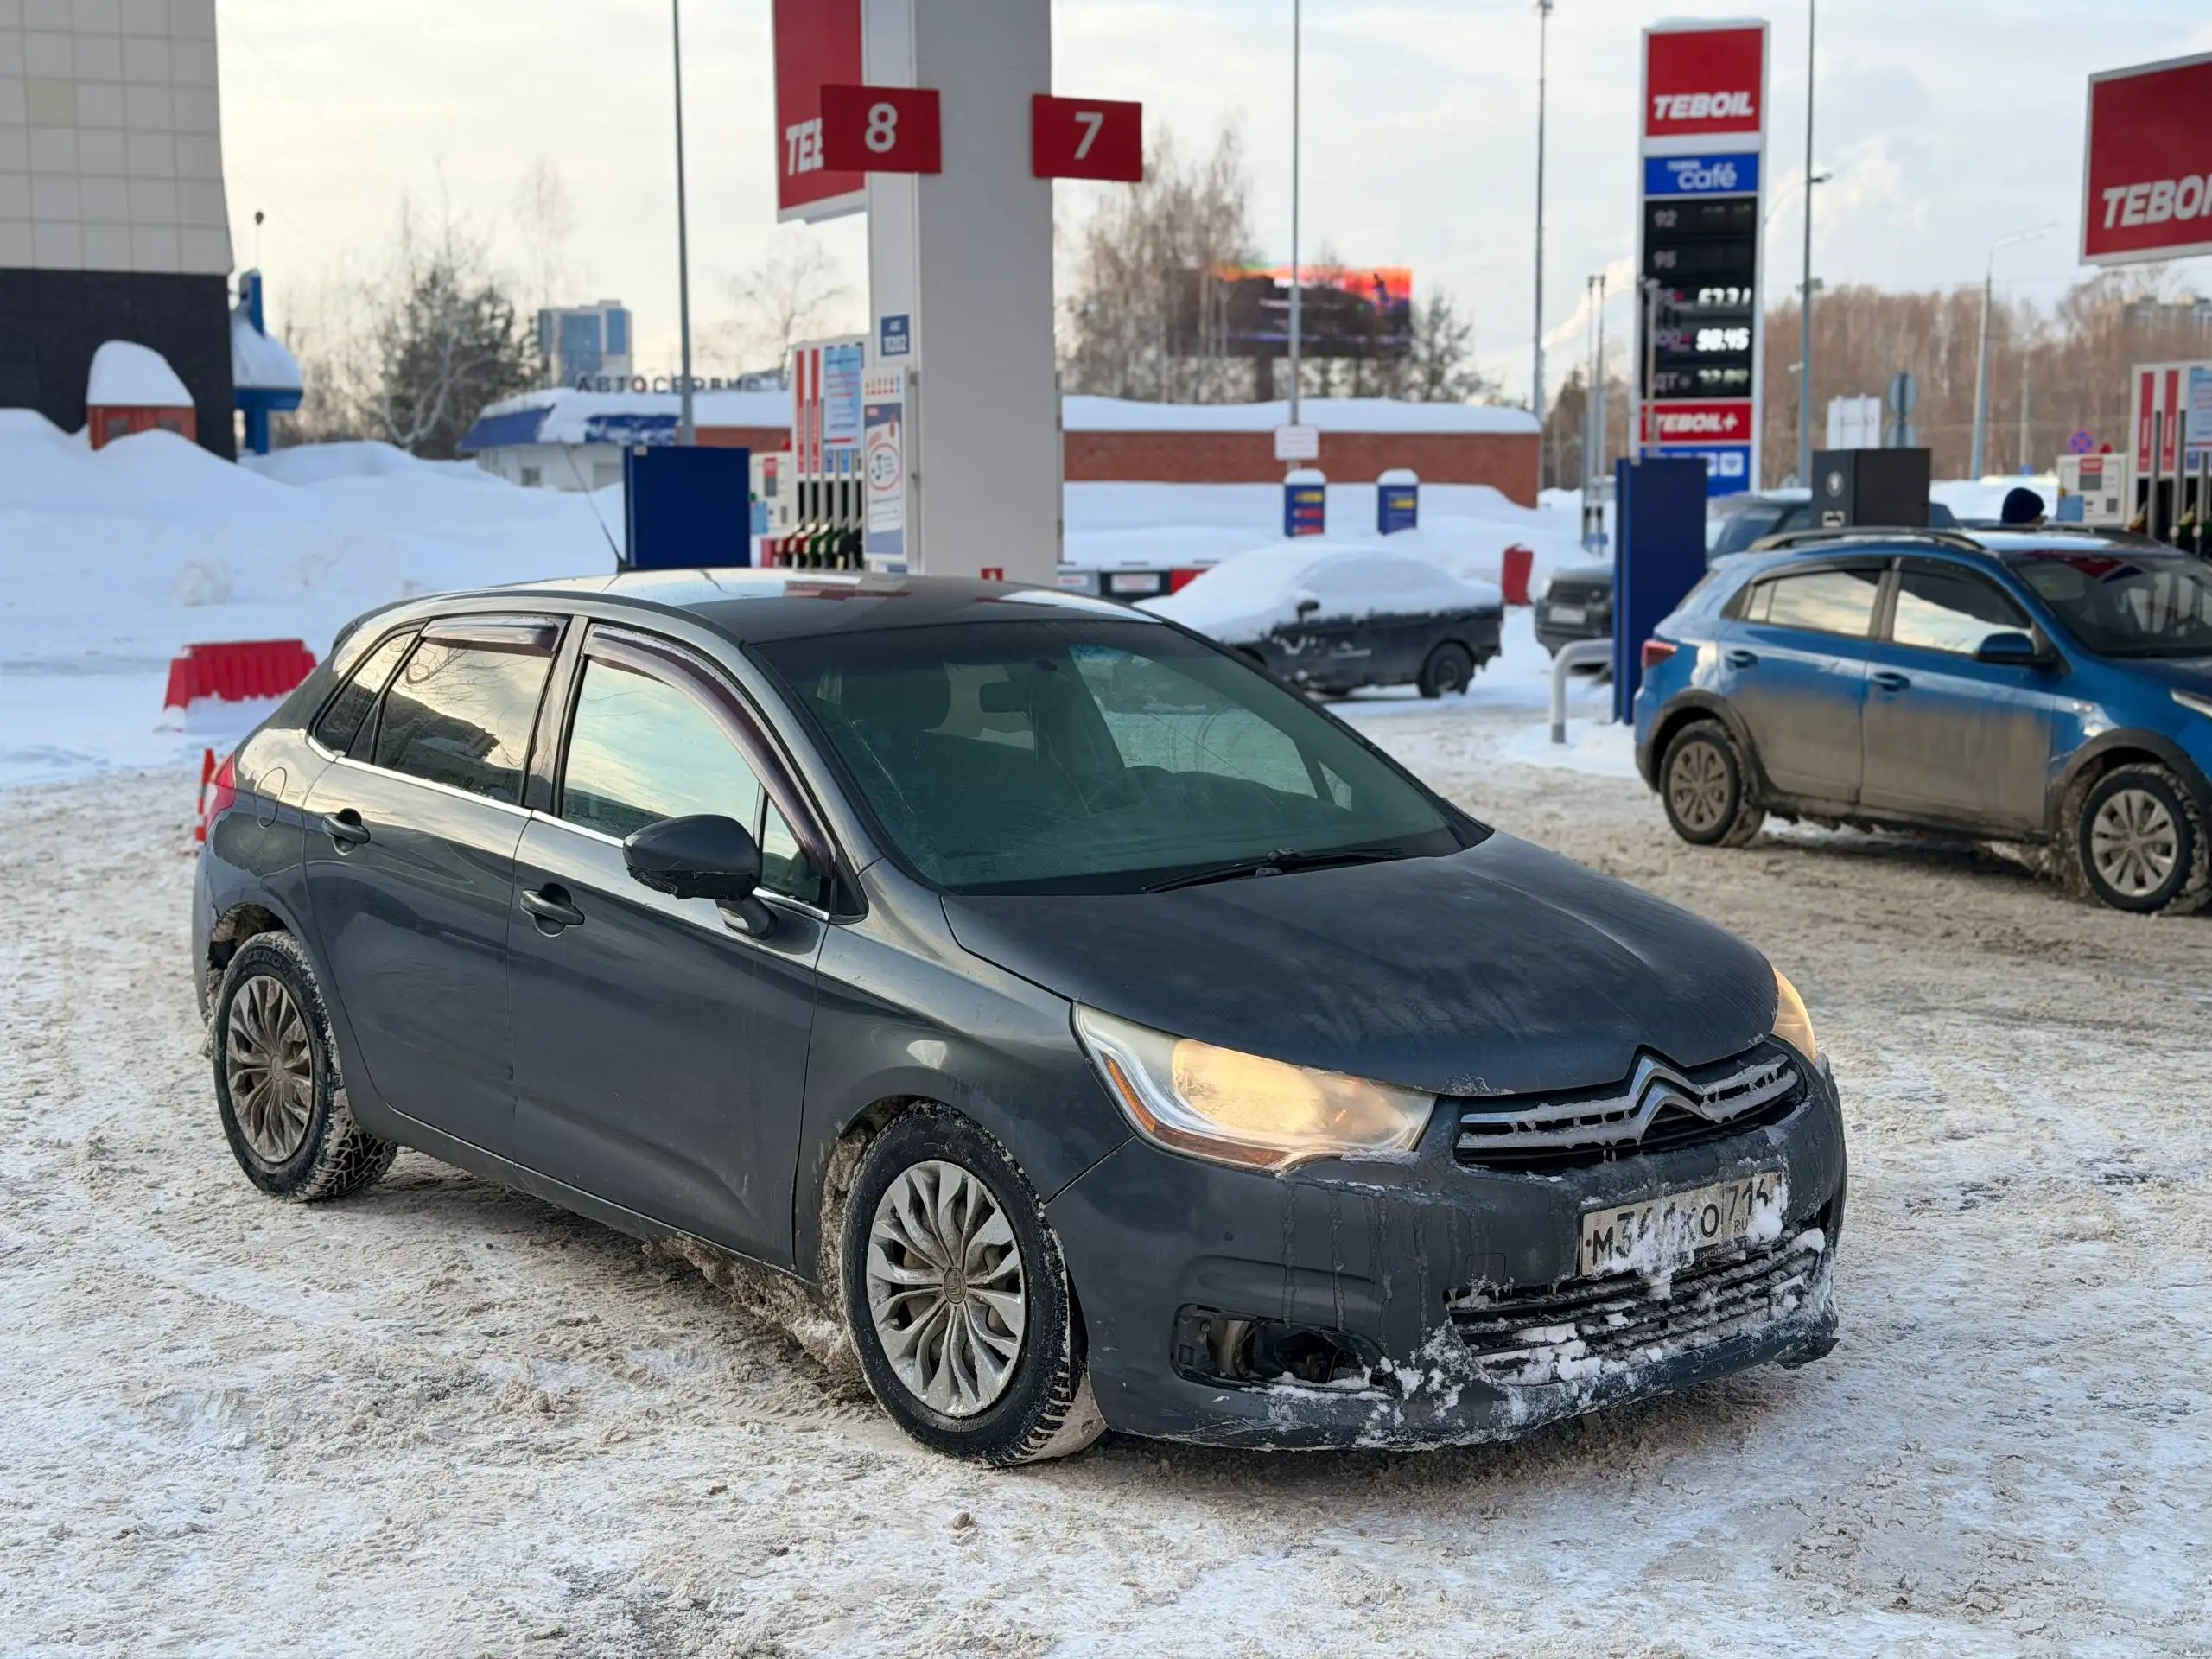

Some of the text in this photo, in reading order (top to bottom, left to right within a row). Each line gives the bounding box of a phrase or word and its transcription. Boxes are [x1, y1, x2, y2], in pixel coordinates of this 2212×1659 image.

[1653, 91, 1755, 120] TEBOIL
[864, 102, 899, 153] 8
[1073, 111, 1104, 160] 7
[1677, 162, 1738, 190] café
[1654, 208, 1678, 227] 92
[1652, 250, 1676, 270] 95
[1733, 1217, 1749, 1233] RU
